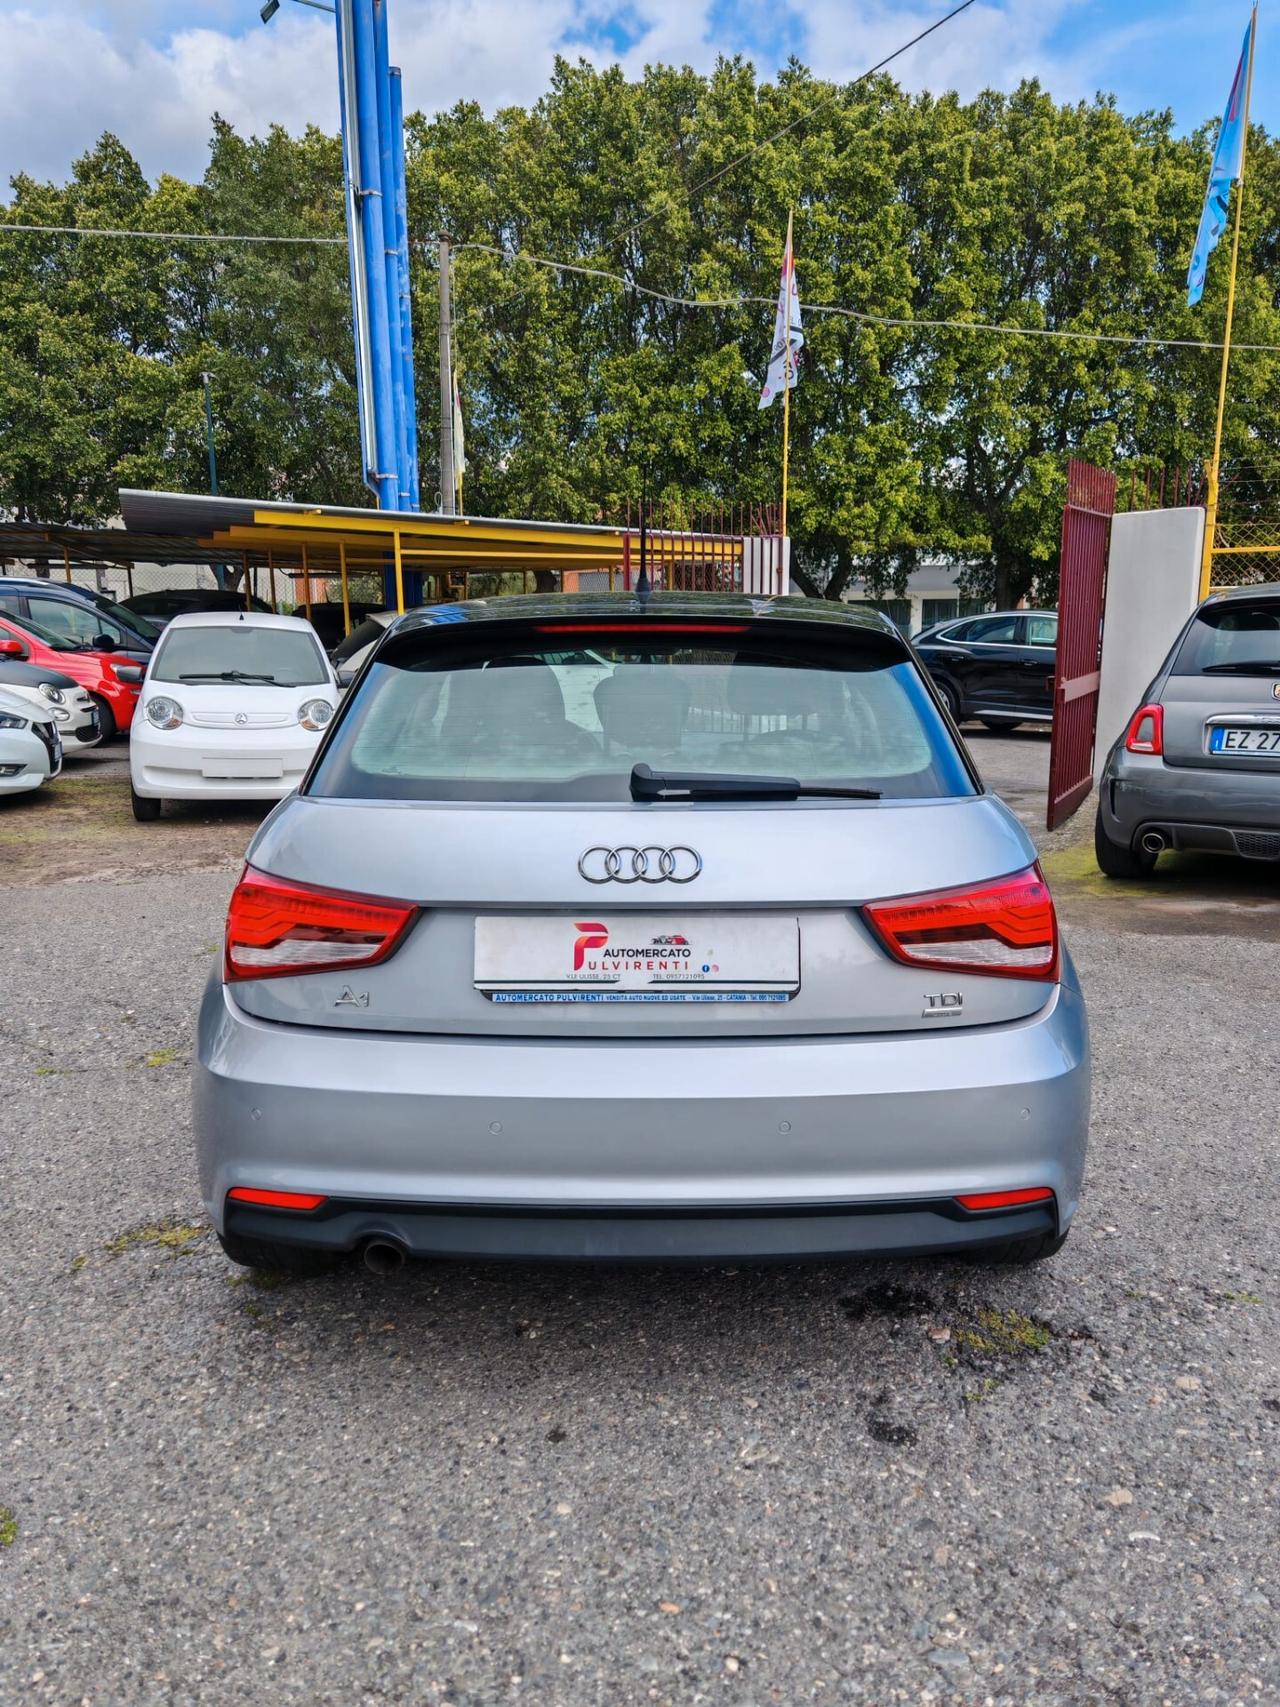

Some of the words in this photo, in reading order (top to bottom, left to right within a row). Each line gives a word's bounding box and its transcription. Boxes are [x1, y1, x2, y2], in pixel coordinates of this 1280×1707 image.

[1225, 731, 1251, 749] EZ
[603, 949, 691, 958] AUTOMERCATO
[335, 985, 369, 1007] A1
[496, 993, 554, 1001] AUTOMERCATO
[557, 993, 604, 1001] PULVIRENTI
[923, 992, 962, 1007] TDI
